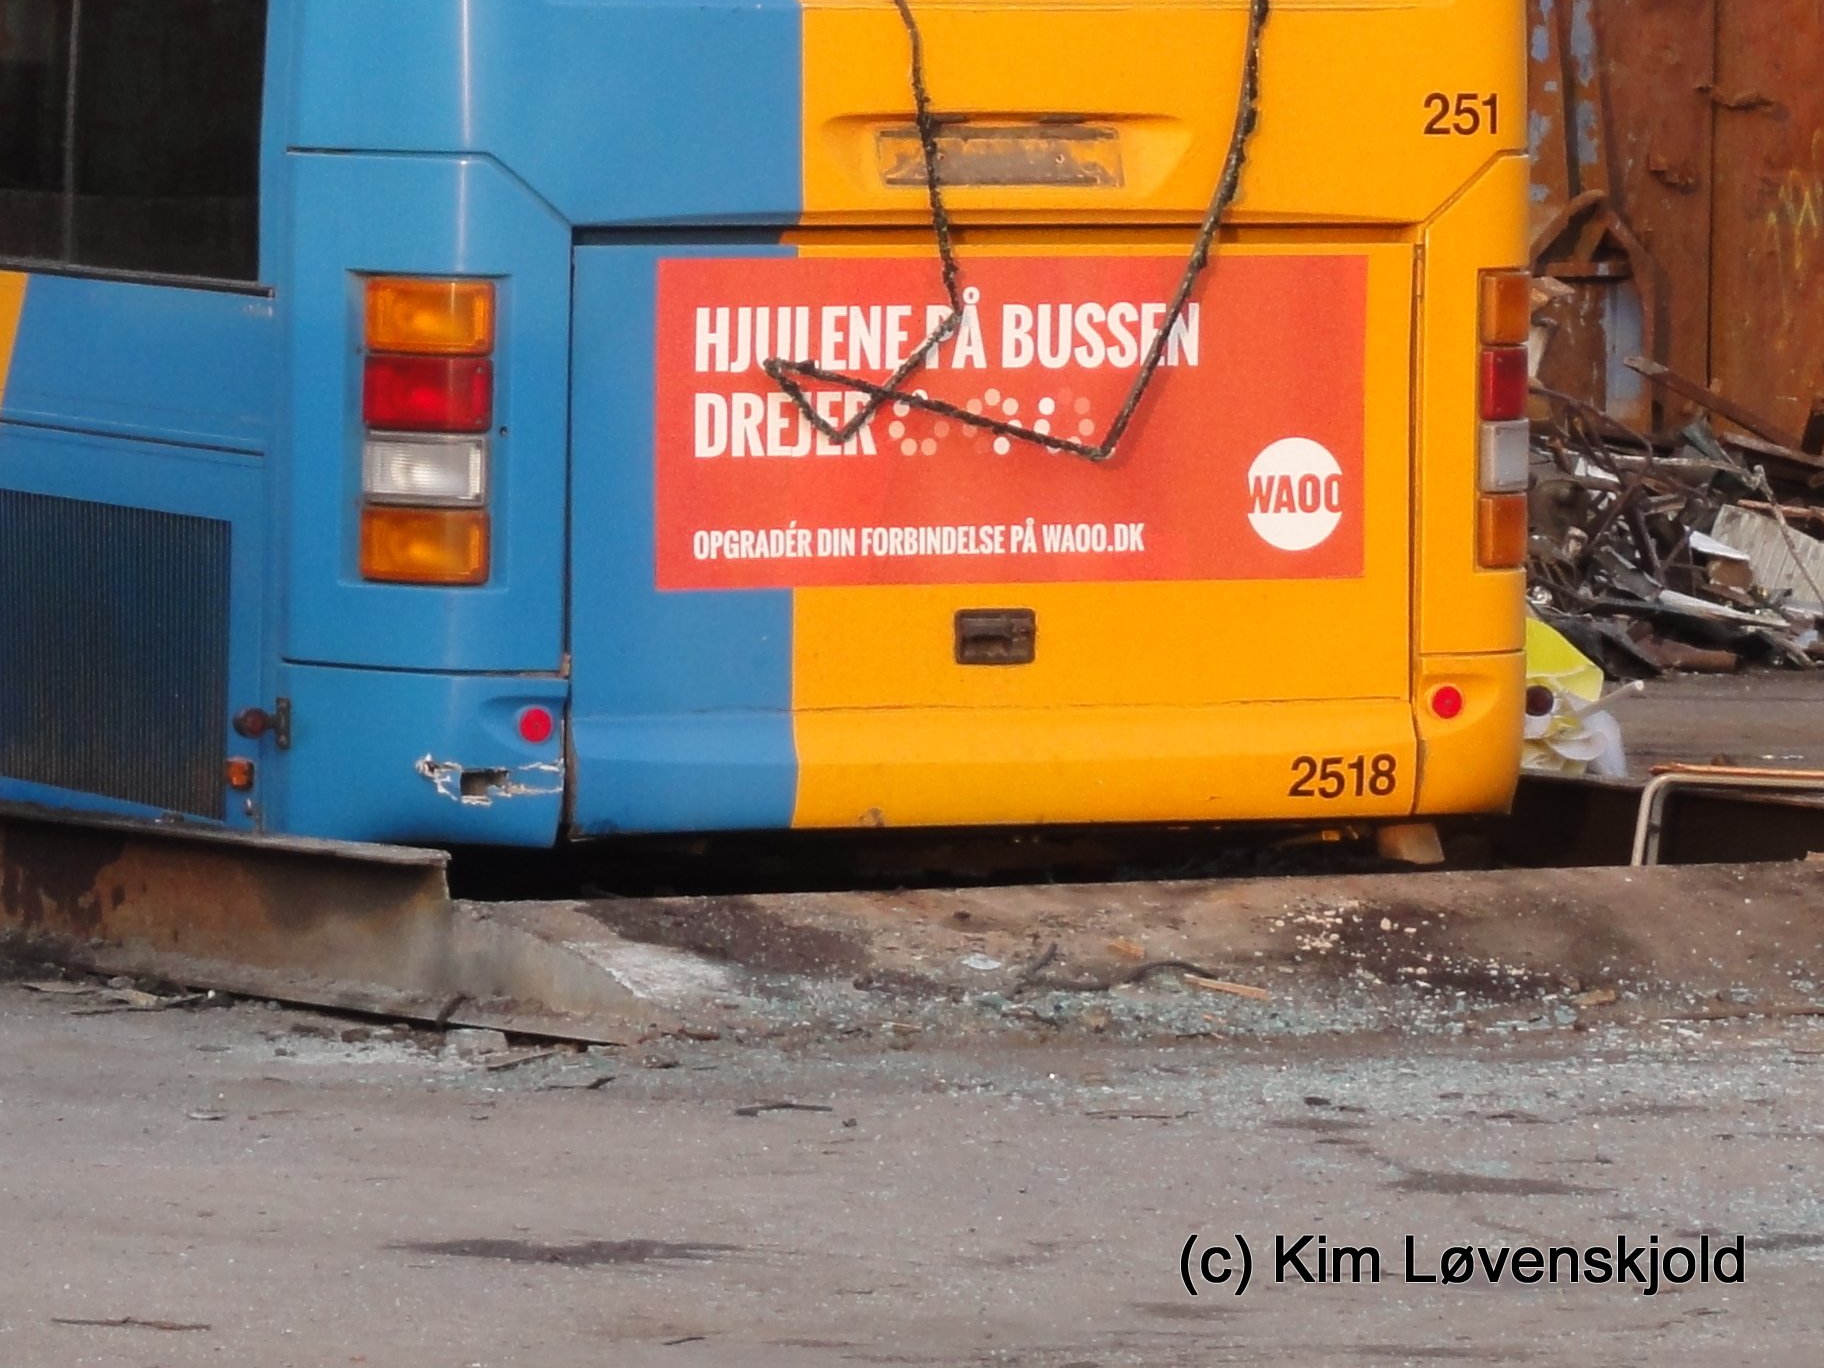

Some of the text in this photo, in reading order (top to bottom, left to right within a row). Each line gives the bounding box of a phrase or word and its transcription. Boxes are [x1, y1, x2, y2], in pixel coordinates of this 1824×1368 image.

[1423, 92, 1498, 135] 251
[694, 286, 1201, 373] HJULENE PÅ BUSSEN
[694, 390, 878, 458] DREJER
[1247, 472, 1344, 515] WAOO
[693, 516, 1146, 561] OPGRADÉR DIN FORBINDELSE PÅ WAOO.DK
[1287, 753, 1397, 799] 2518
